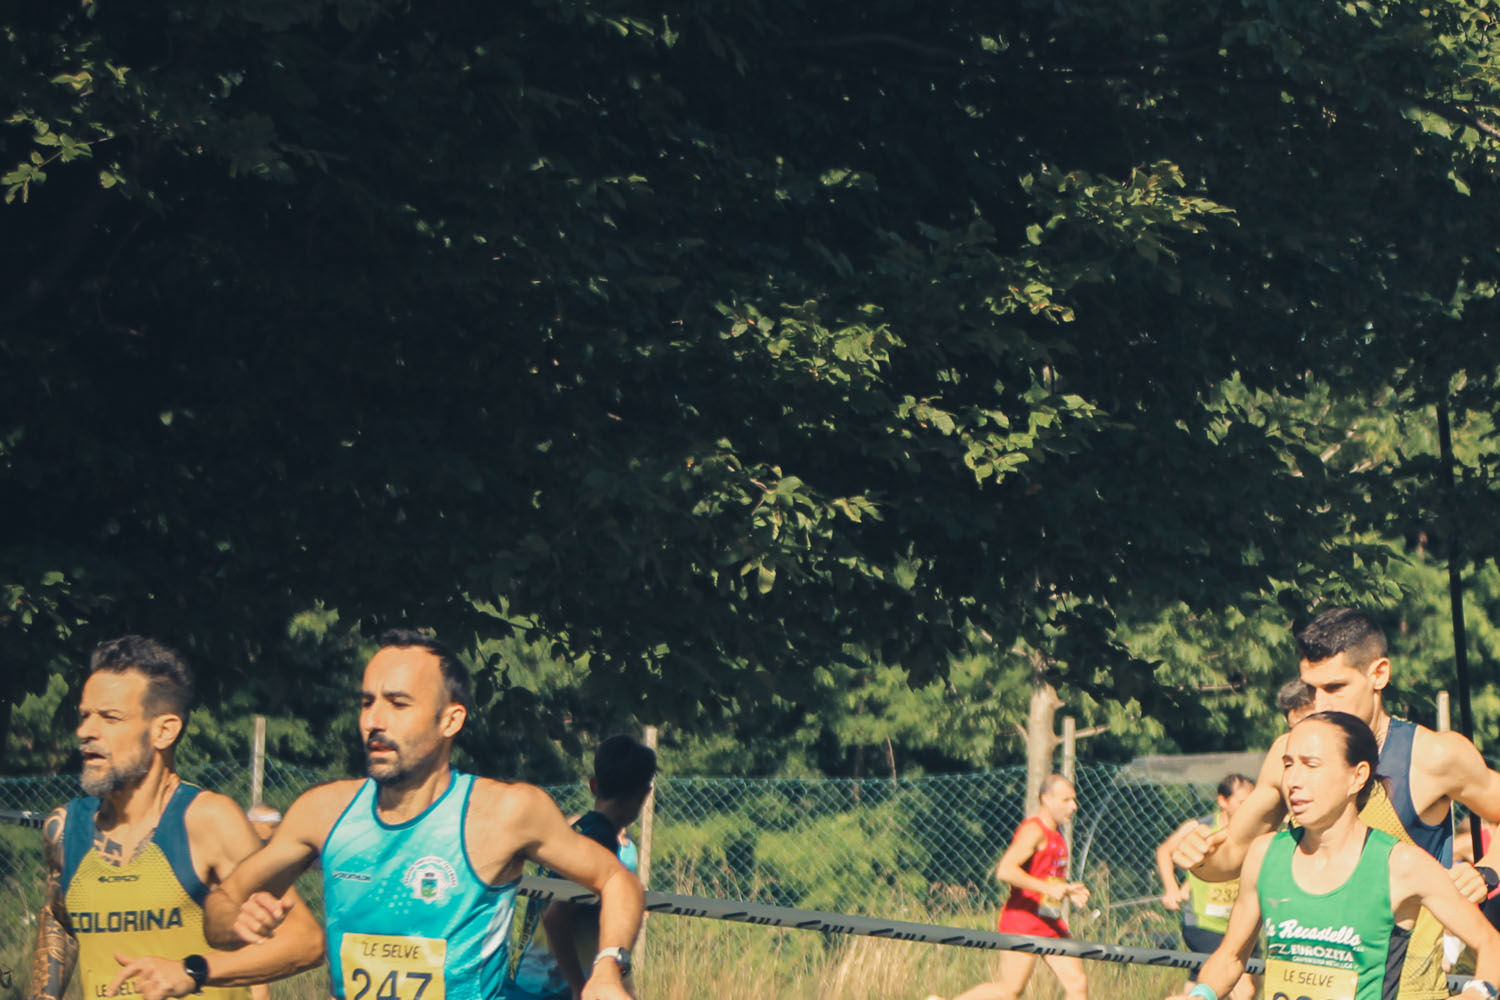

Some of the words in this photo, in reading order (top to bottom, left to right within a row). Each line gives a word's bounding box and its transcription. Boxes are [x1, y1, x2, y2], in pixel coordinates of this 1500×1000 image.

[68, 908, 183, 933] COLORINA
[362, 940, 378, 957] LE
[382, 944, 421, 959] SELVE
[1290, 944, 1354, 962] EUROZETA
[1283, 969, 1295, 982] LE
[1298, 971, 1335, 988] SELVE
